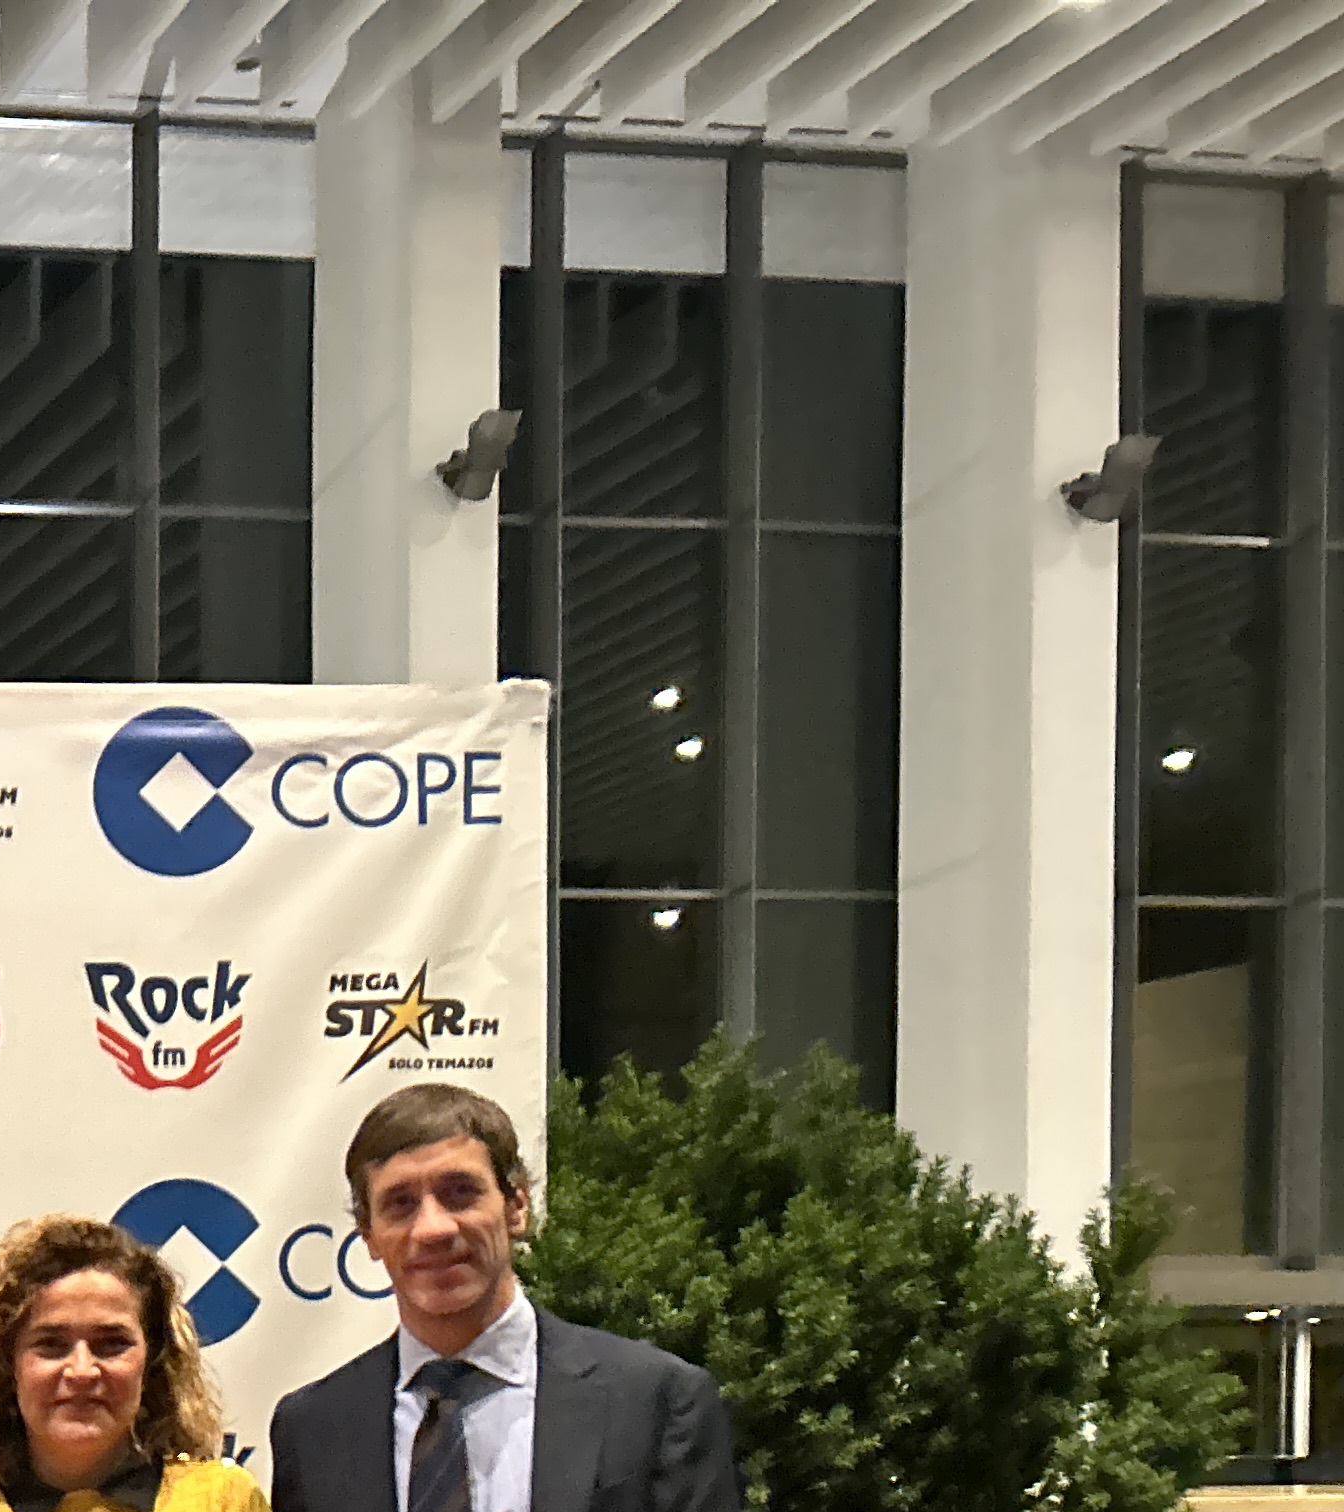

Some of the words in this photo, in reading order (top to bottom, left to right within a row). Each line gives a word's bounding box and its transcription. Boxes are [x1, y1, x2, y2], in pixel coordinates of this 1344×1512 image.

[272, 751, 502, 826] COPE
[329, 973, 398, 992] MEGA
[85, 961, 251, 1037] Rock
[468, 1018, 498, 1036] FM
[152, 1042, 185, 1068] fm
[389, 1058, 423, 1069] SOLO
[427, 1058, 493, 1069] TEMAZOS
